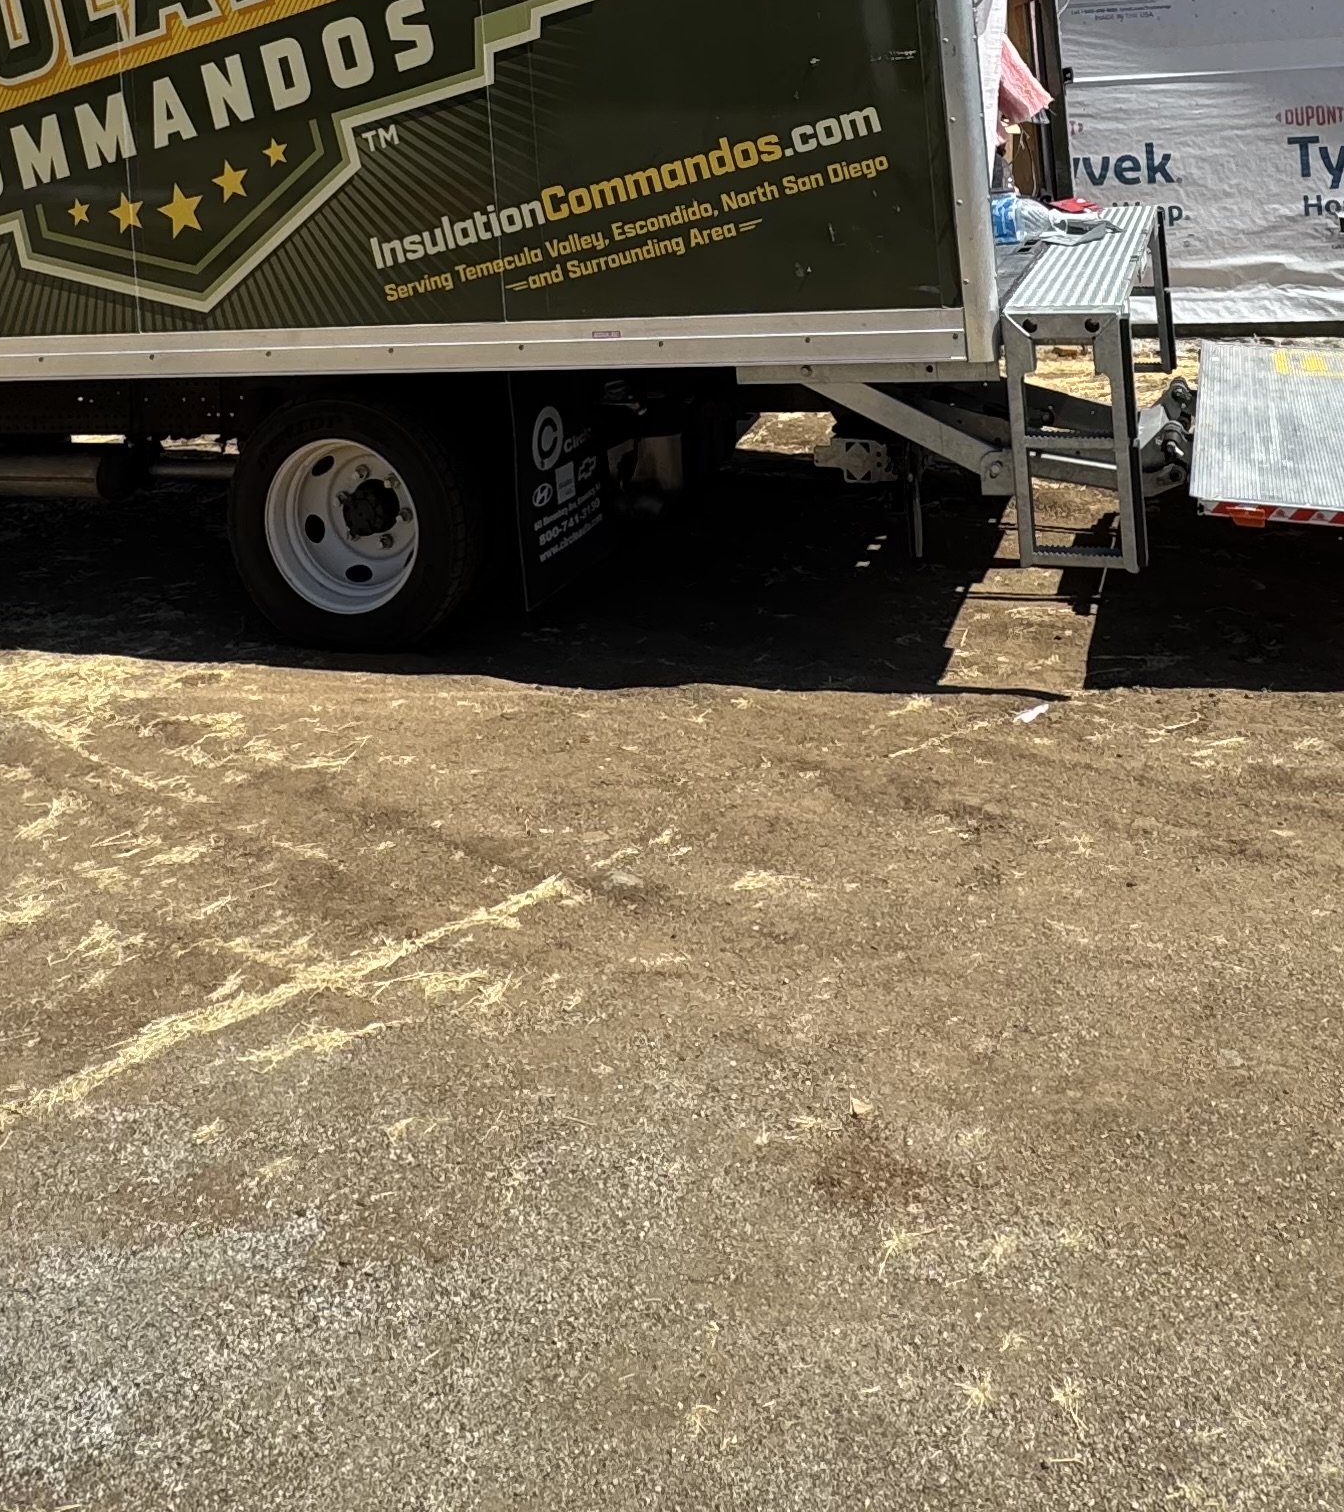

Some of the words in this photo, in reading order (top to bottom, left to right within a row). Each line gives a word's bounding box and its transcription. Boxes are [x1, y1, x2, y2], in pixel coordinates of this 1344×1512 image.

[362, 124, 400, 153] TM
[1285, 105, 1344, 126] DUPONT
[370, 105, 881, 269] InsulationCommandos.com
[1073, 142, 1175, 186] vek
[384, 271, 453, 302] Serving
[455, 247, 543, 284] Temecula
[545, 231, 610, 260] Valley,
[611, 201, 719, 241] Escondido,
[722, 183, 779, 212] North
[784, 171, 824, 195] San
[830, 153, 889, 183] Diego
[528, 264, 563, 290] and
[567, 234, 684, 283] Surrounding
[690, 223, 736, 248] Area
